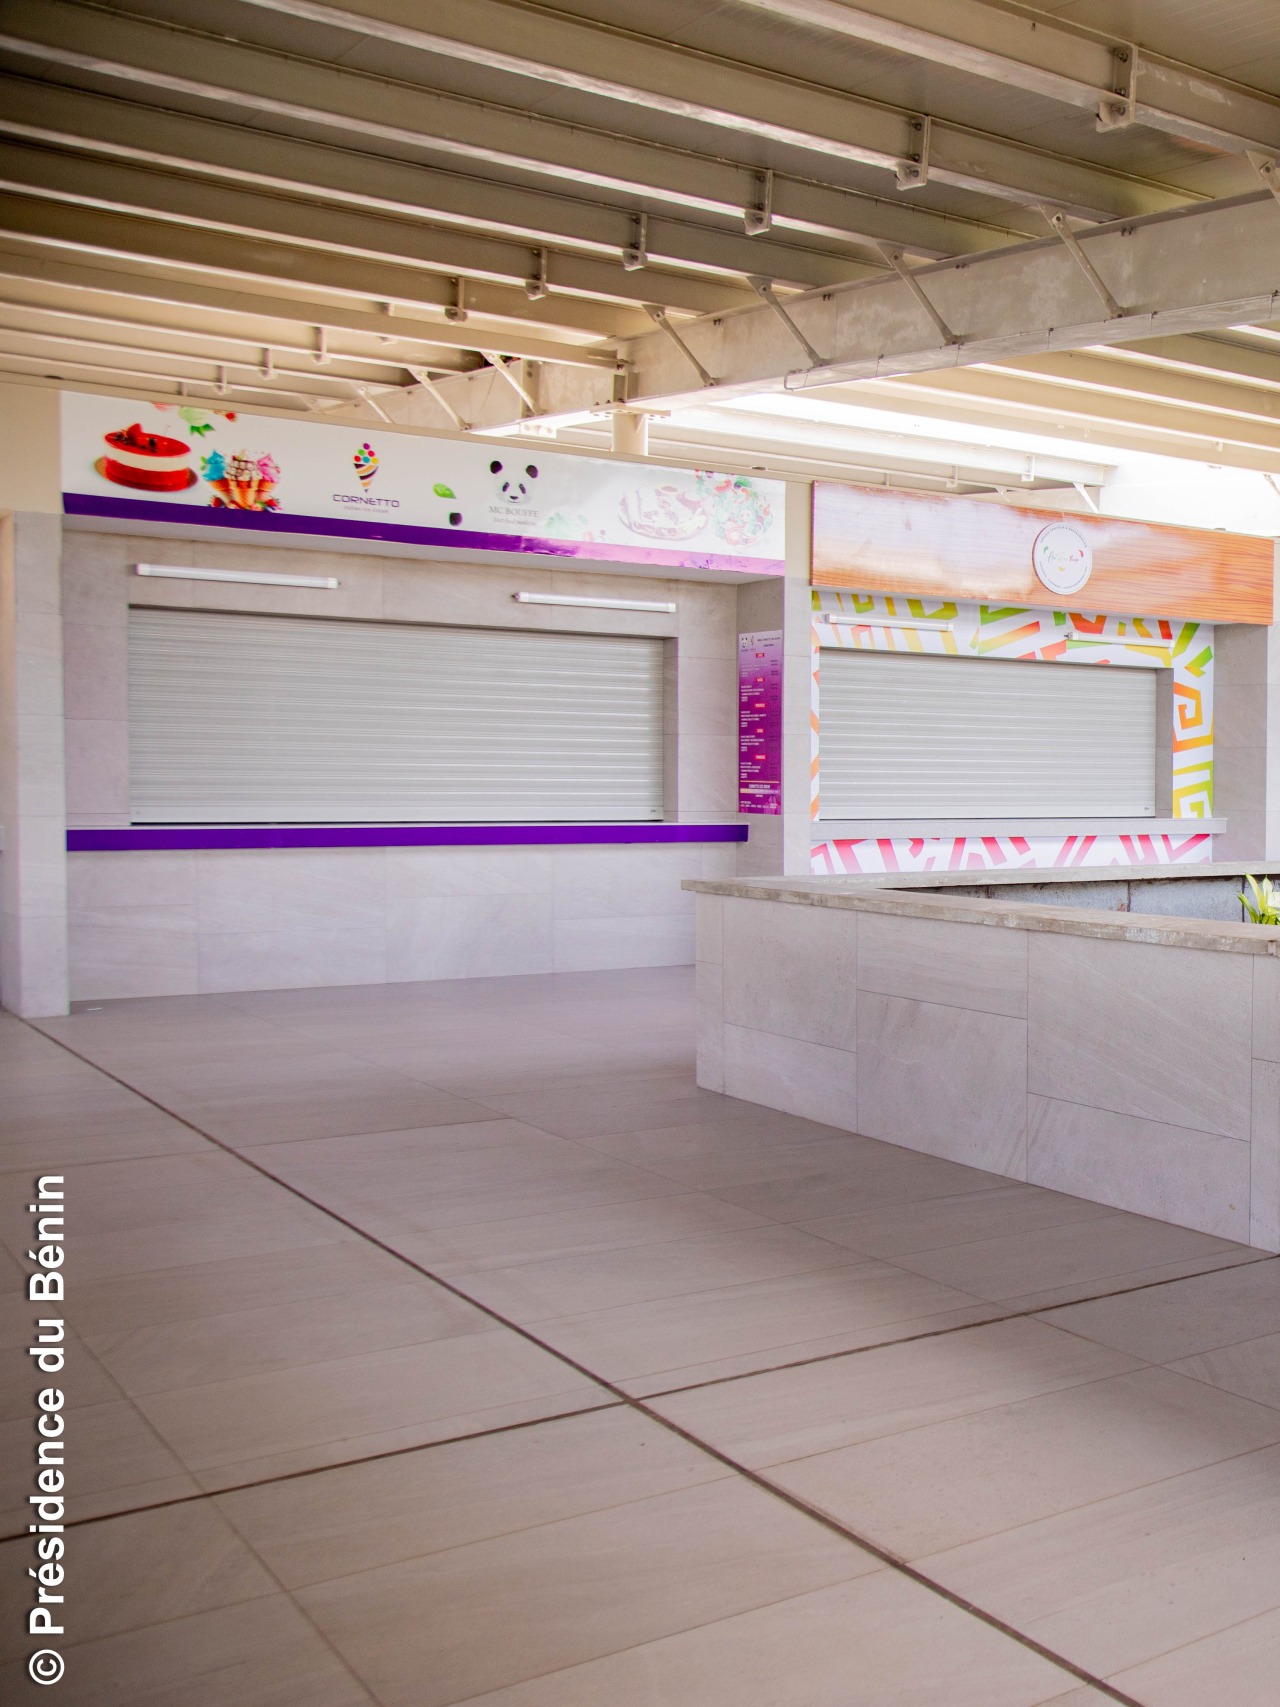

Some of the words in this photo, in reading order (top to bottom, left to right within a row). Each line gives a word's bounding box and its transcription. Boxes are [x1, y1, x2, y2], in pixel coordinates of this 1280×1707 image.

[332, 494, 401, 508] CORNETTO
[488, 505, 503, 514] MC
[505, 507, 539, 518] BOUFFE
